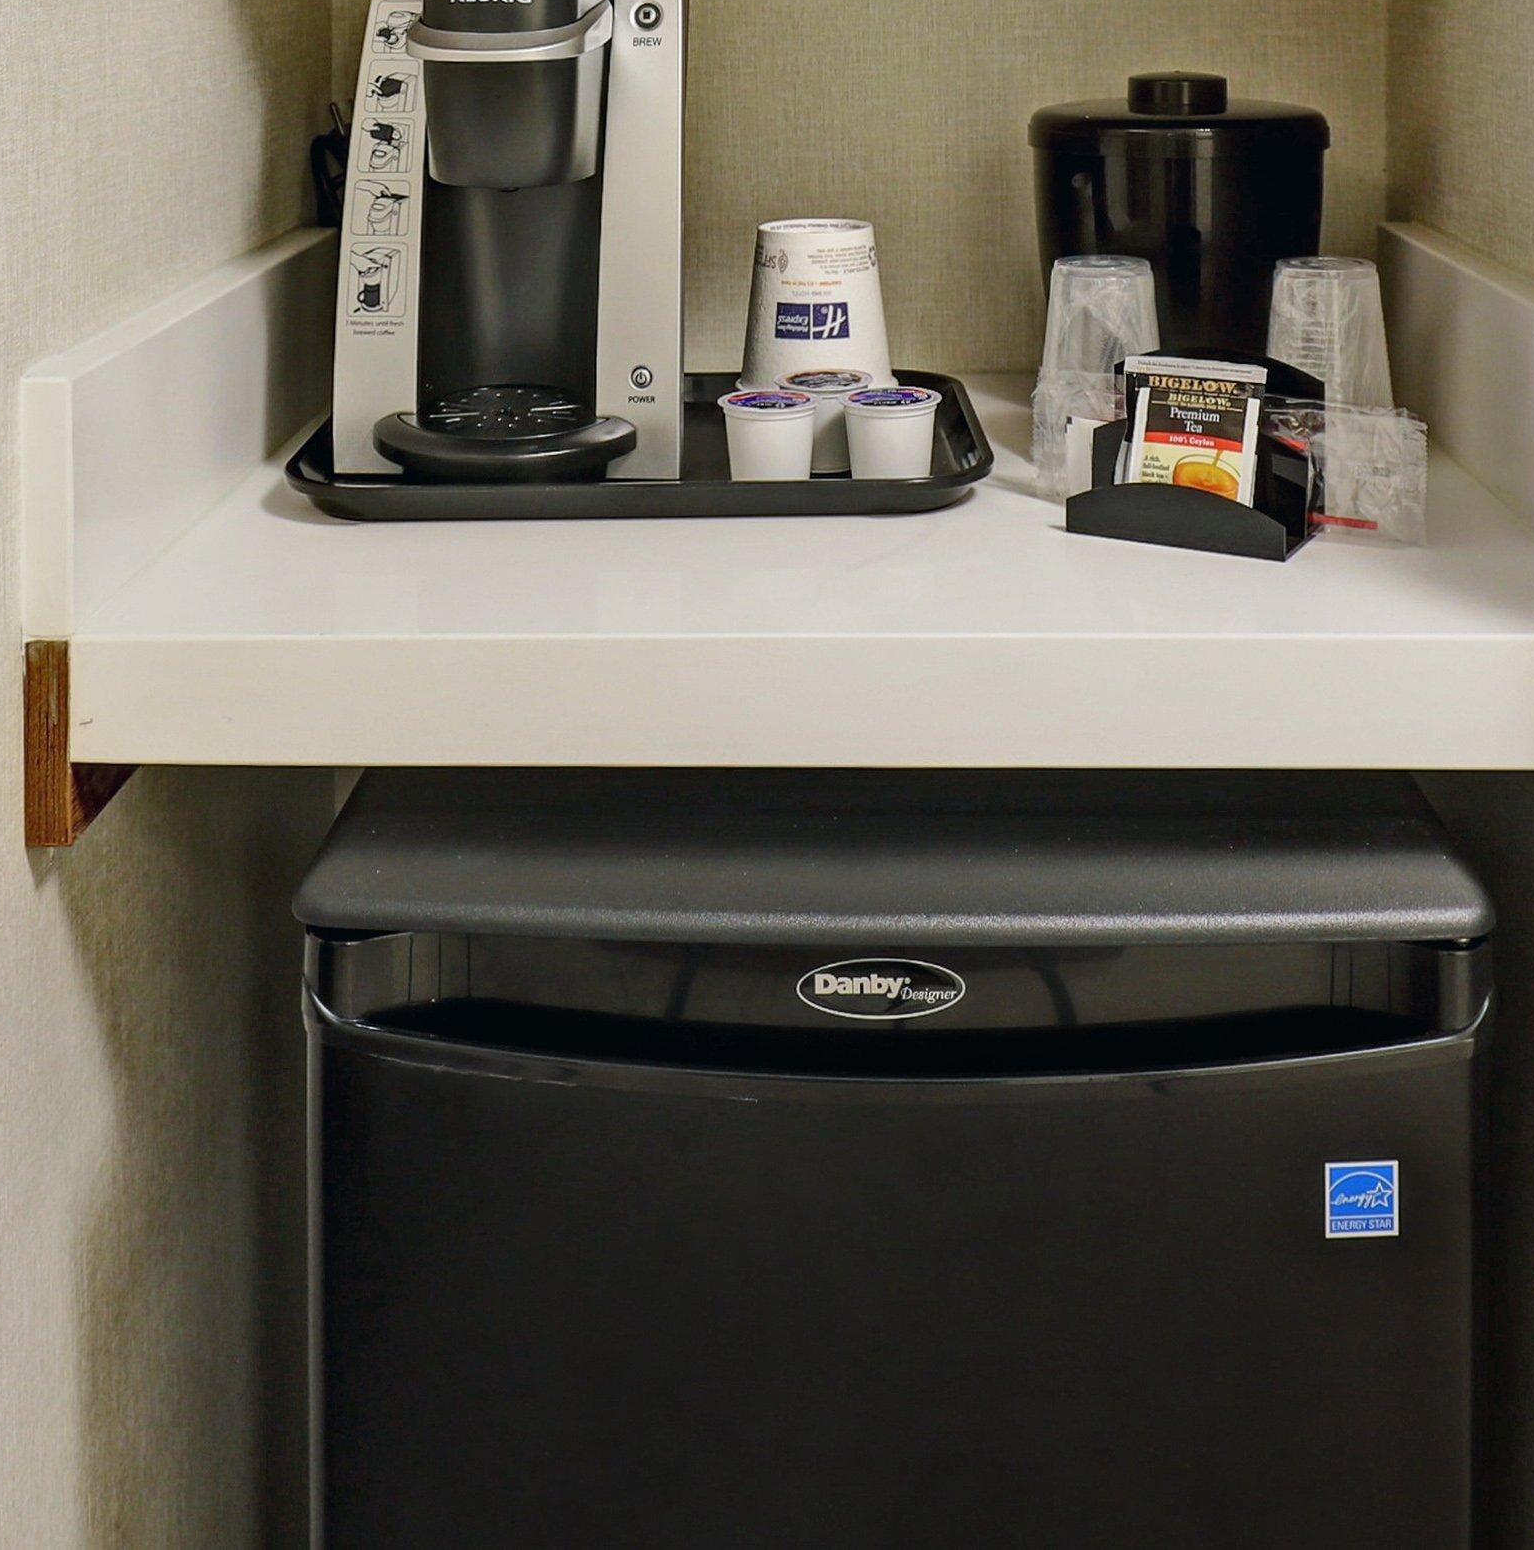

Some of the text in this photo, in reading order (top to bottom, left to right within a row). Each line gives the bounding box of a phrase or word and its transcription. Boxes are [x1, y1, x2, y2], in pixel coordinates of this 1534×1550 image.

[632, 37, 662, 47] BREW
[777, 315, 809, 325] Express
[1149, 375, 1237, 393] BIGELOW
[627, 395, 656, 404] POWER
[1169, 393, 1227, 406] BIGELOW
[1170, 407, 1220, 423] Premium
[1184, 420, 1203, 433] Tea
[1189, 437, 1215, 447] Ceylon
[814, 973, 957, 1004] Danby Designer
[1331, 1218, 1392, 1231] ENERGY STAR
